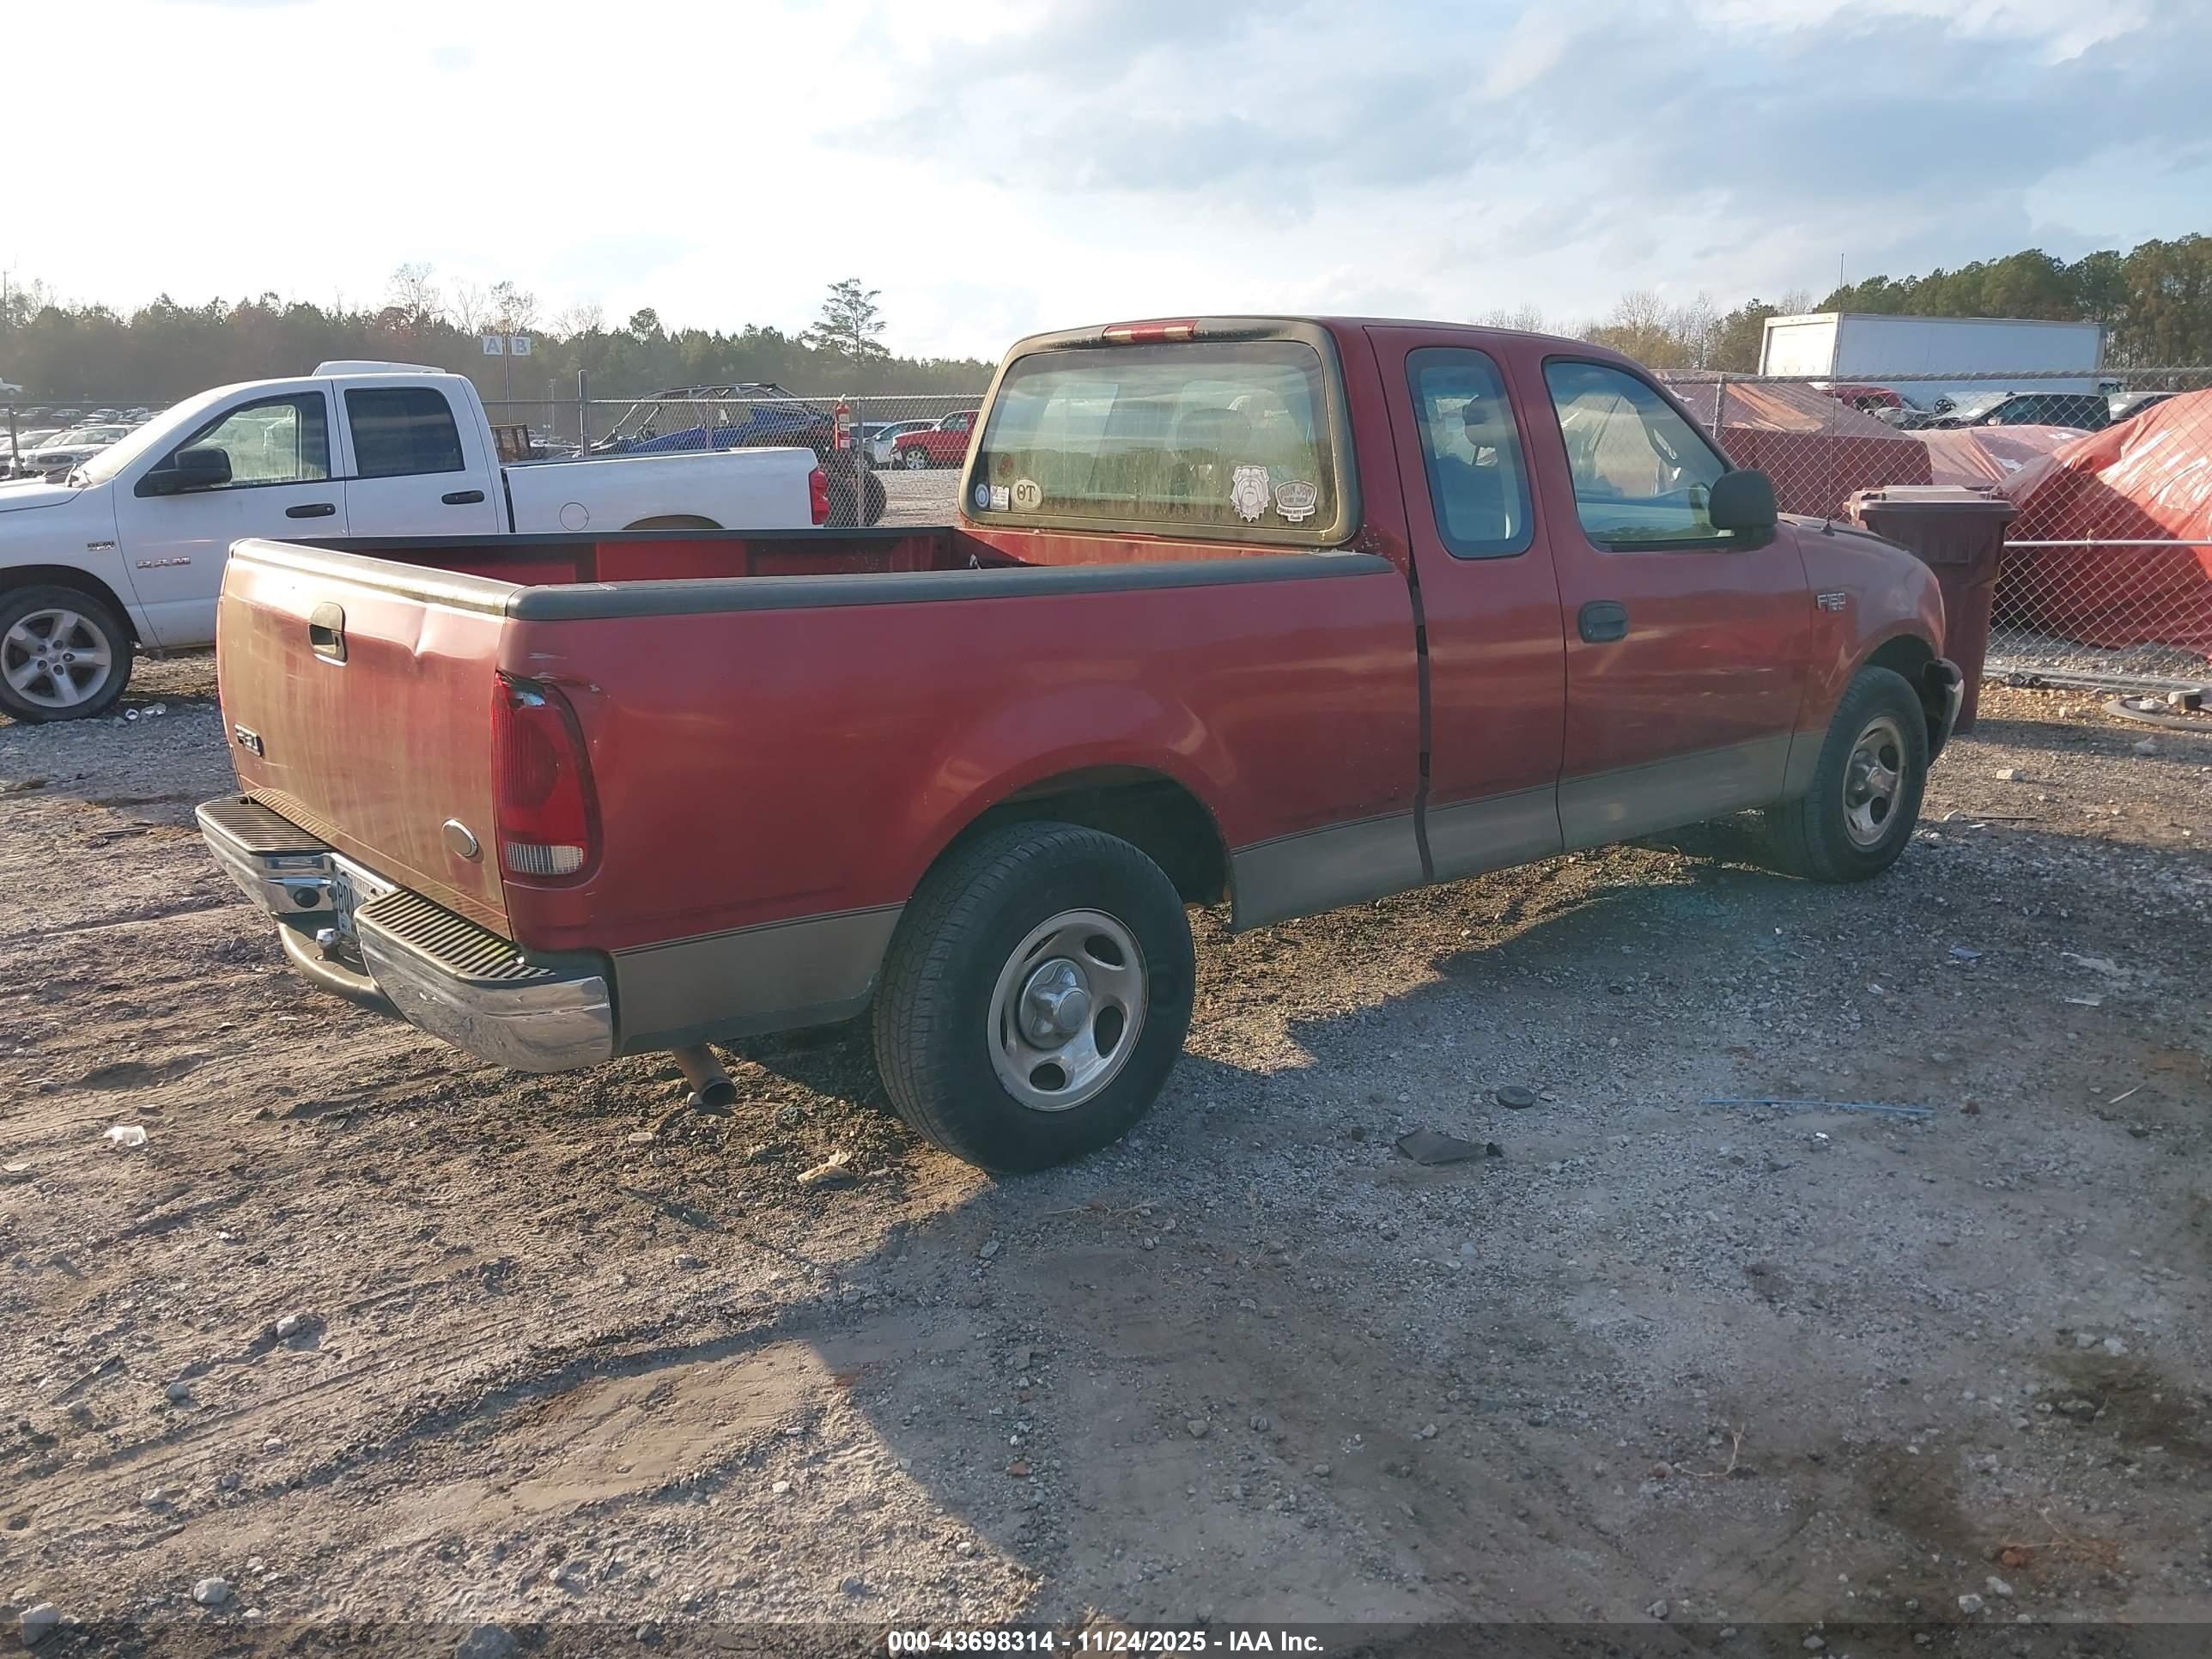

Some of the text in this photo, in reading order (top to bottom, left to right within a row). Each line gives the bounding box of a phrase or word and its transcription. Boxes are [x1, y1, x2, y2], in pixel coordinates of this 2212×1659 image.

[486, 337, 527, 353] A B
[137, 556, 191, 568] RAM
